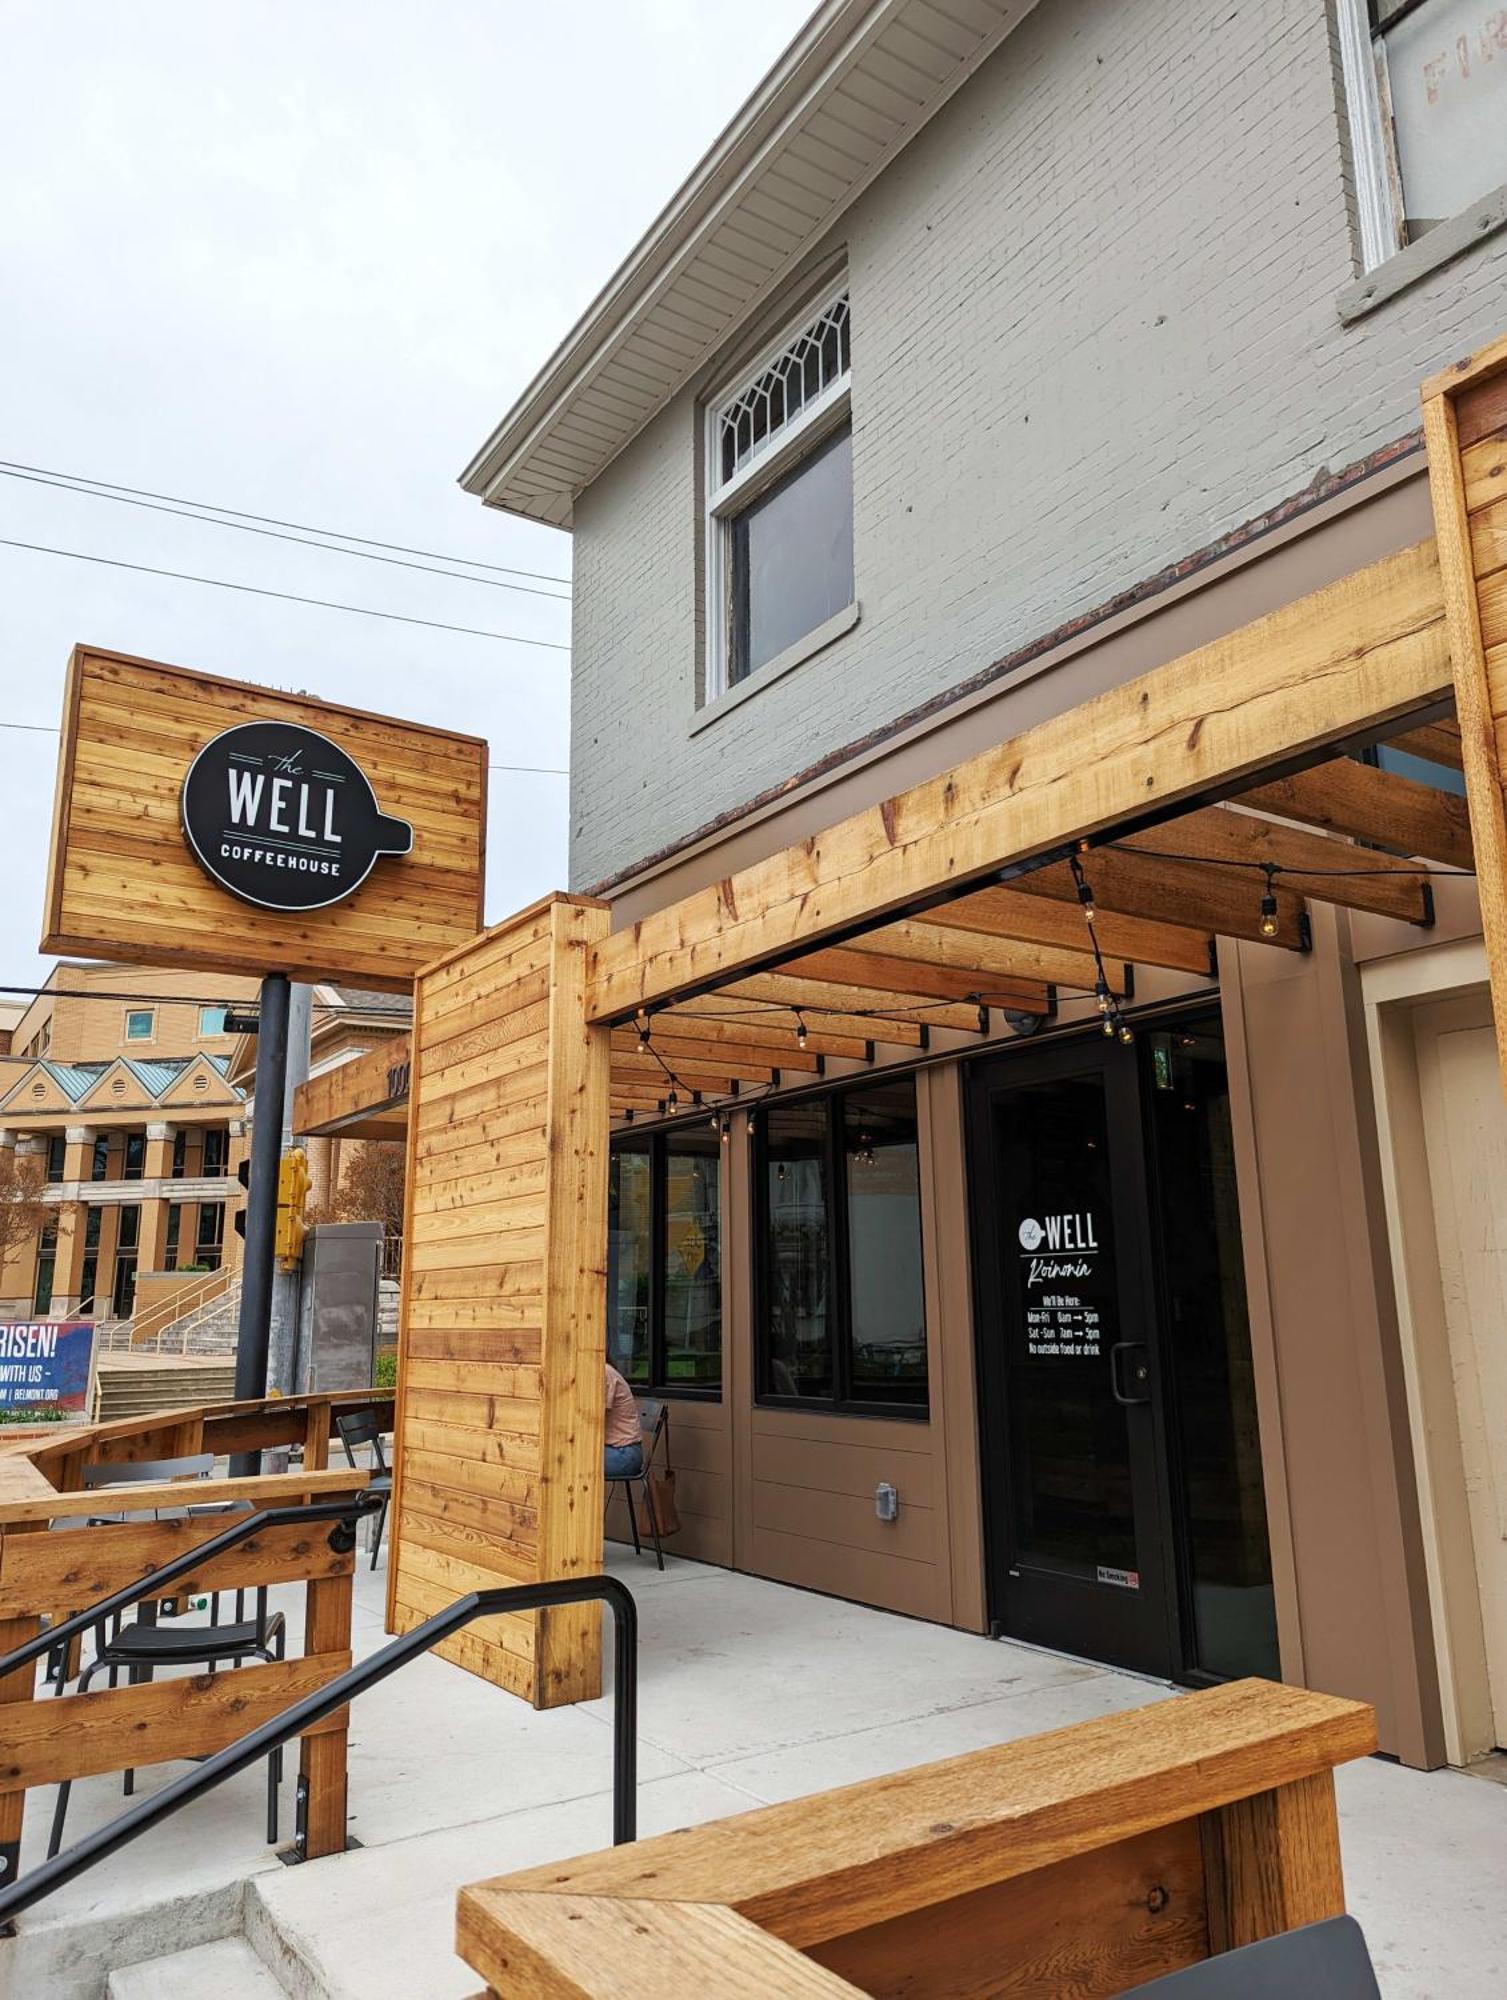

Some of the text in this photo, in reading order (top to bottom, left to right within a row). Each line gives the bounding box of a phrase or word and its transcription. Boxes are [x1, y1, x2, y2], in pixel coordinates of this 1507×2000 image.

[268, 750, 303, 776] the
[228, 768, 342, 843] WELL
[221, 844, 340, 877] COFFEEHOUSE
[1045, 1213, 1098, 1250] WELL
[1057, 1295, 1065, 1306] Be
[1084, 1311, 1099, 1325] 5pm
[1060, 1327, 1073, 1338] 7am
[1085, 1327, 1100, 1341] 5pm
[1029, 1342, 1101, 1355] No outside food or drink
[0, 1365, 26, 1382] WITH
[28, 1365, 43, 1382] US
[14, 1388, 59, 1401] BELMONT.ORG
